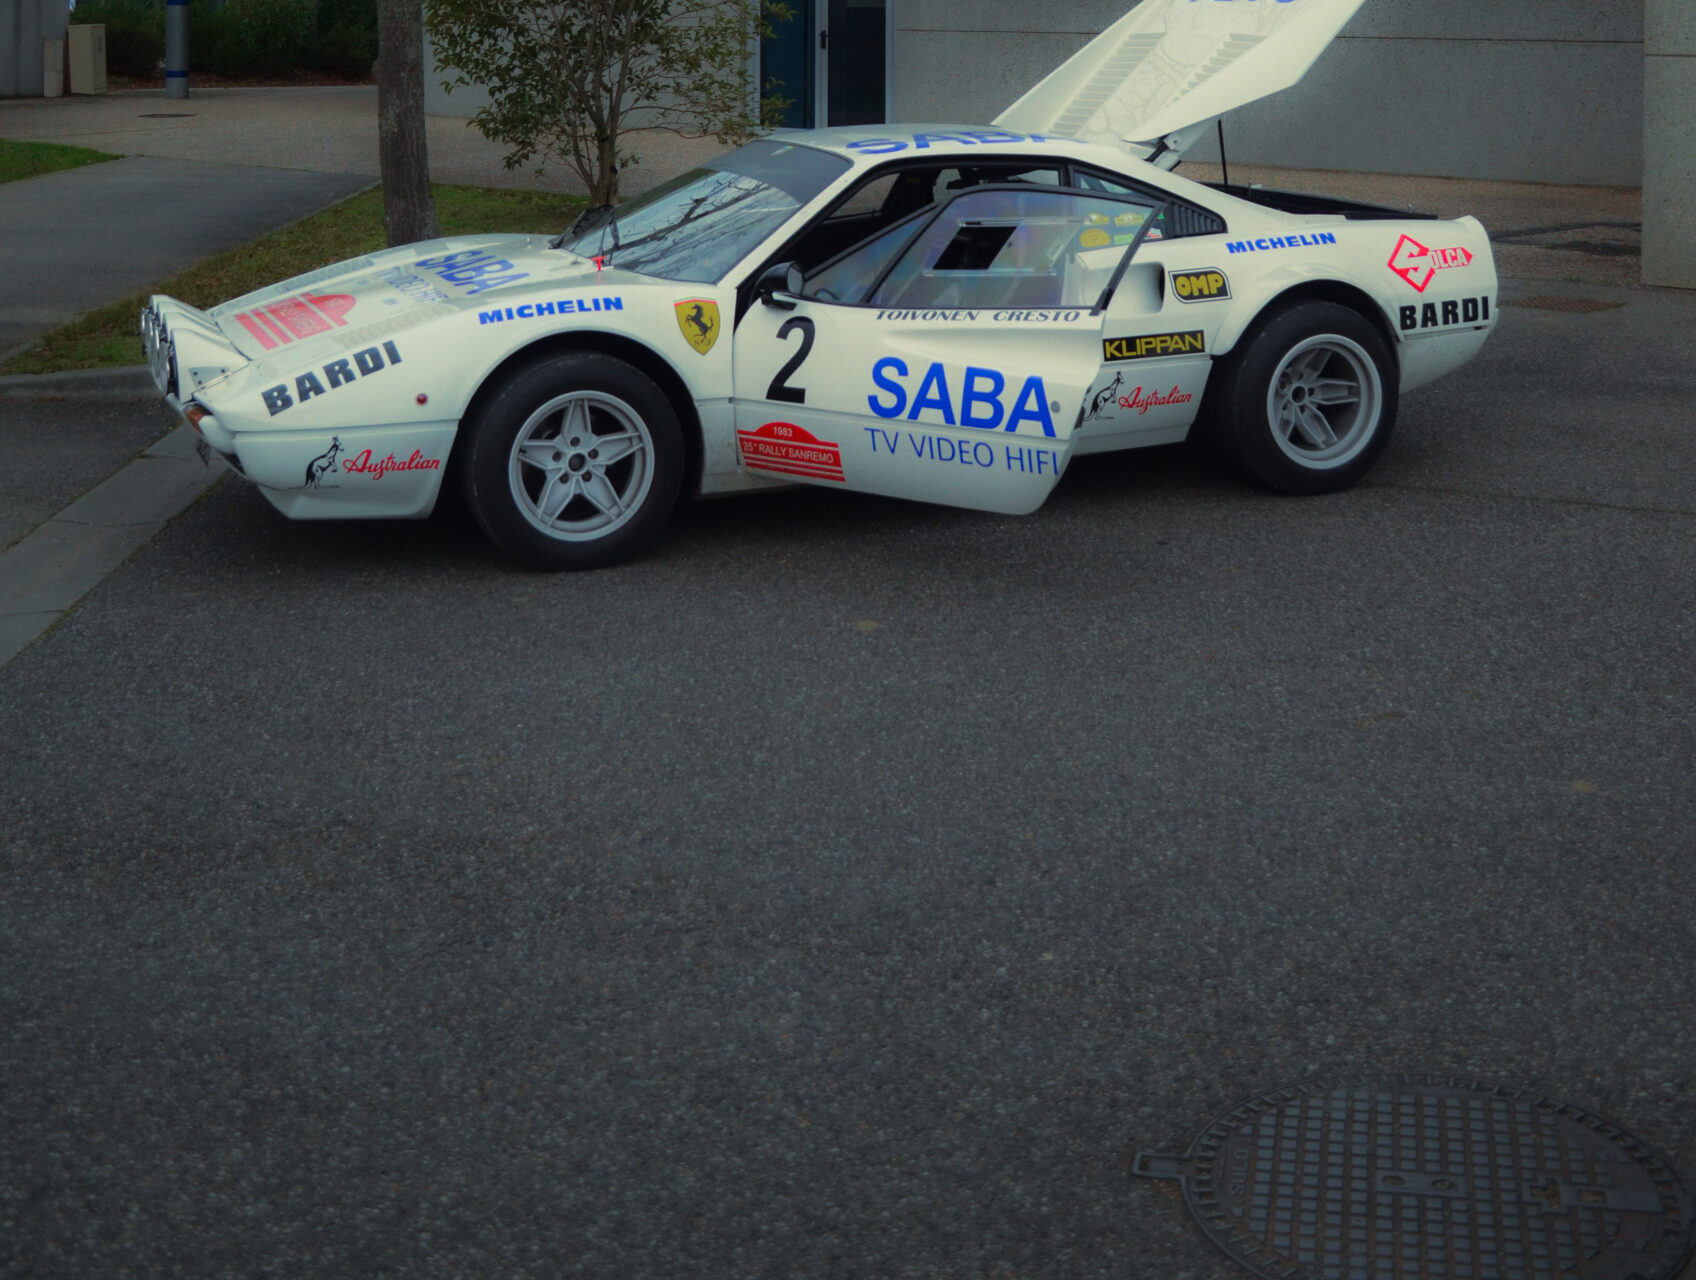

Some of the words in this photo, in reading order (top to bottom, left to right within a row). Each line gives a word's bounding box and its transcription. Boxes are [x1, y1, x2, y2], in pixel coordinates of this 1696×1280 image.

[1226, 231, 1337, 255] MICHELIN
[415, 250, 530, 295] SABA
[1175, 272, 1224, 297] OMP
[478, 296, 624, 325] MICHELIN
[876, 310, 980, 322] TOIVONEN
[993, 310, 1081, 322] CRESTO
[1399, 295, 1490, 331] BARDI
[765, 315, 816, 405] 2
[1104, 332, 1203, 359] KLIPPAN
[261, 340, 402, 416] BARDI
[866, 356, 1057, 440] SABA
[1118, 384, 1192, 414] Australian
[773, 426, 793, 438] 1983
[342, 448, 441, 480] Australian
[758, 443, 787, 457] RALLY
[788, 447, 834, 464] SANREMO
[864, 427, 899, 454] TV
[908, 433, 994, 468] VIDEO
[1005, 445, 1060, 476] HIFI
